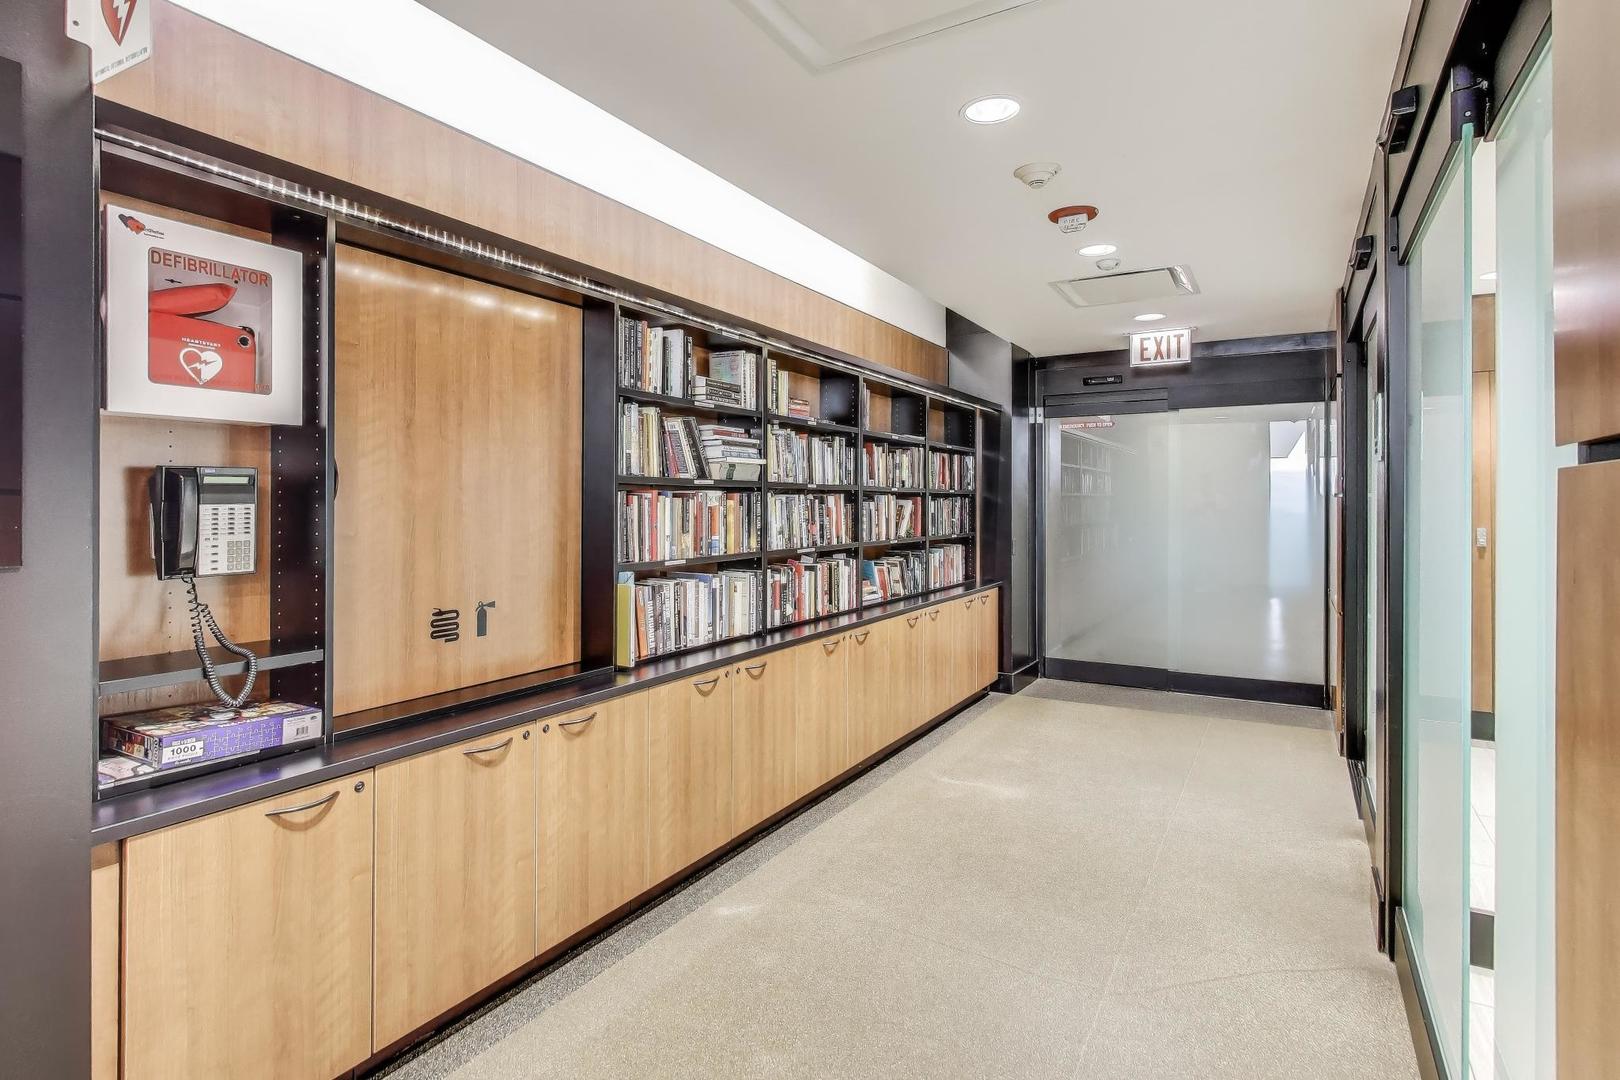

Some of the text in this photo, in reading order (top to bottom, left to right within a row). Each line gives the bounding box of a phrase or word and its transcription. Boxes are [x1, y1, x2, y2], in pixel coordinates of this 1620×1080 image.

[150, 249, 269, 287] DEFIBRILLATOR
[1140, 333, 1184, 362] EXIT
[170, 744, 197, 756] 1000
